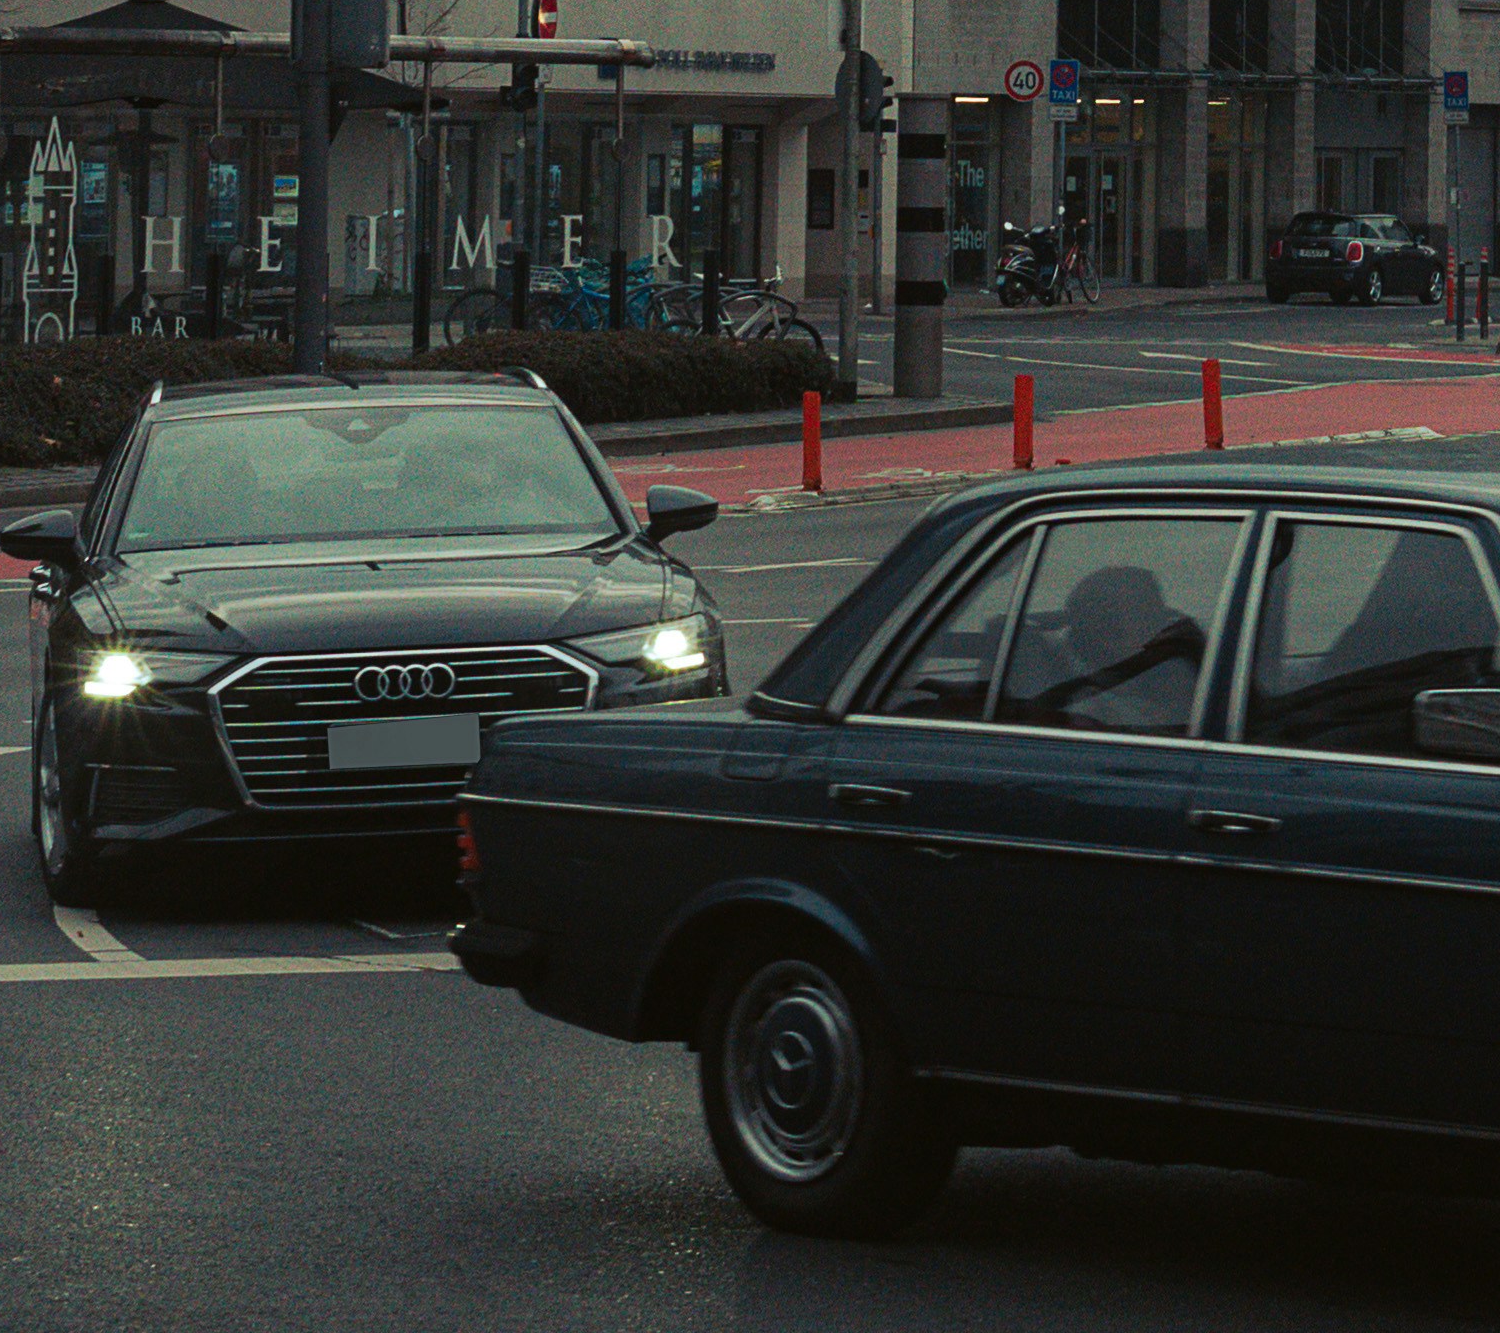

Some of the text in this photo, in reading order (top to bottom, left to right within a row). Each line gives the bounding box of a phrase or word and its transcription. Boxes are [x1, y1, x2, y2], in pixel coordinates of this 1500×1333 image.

[1013, 72, 1036, 90] 40
[1052, 90, 1076, 100] TAXI
[958, 160, 985, 187] The
[131, 316, 190, 339] BAR
